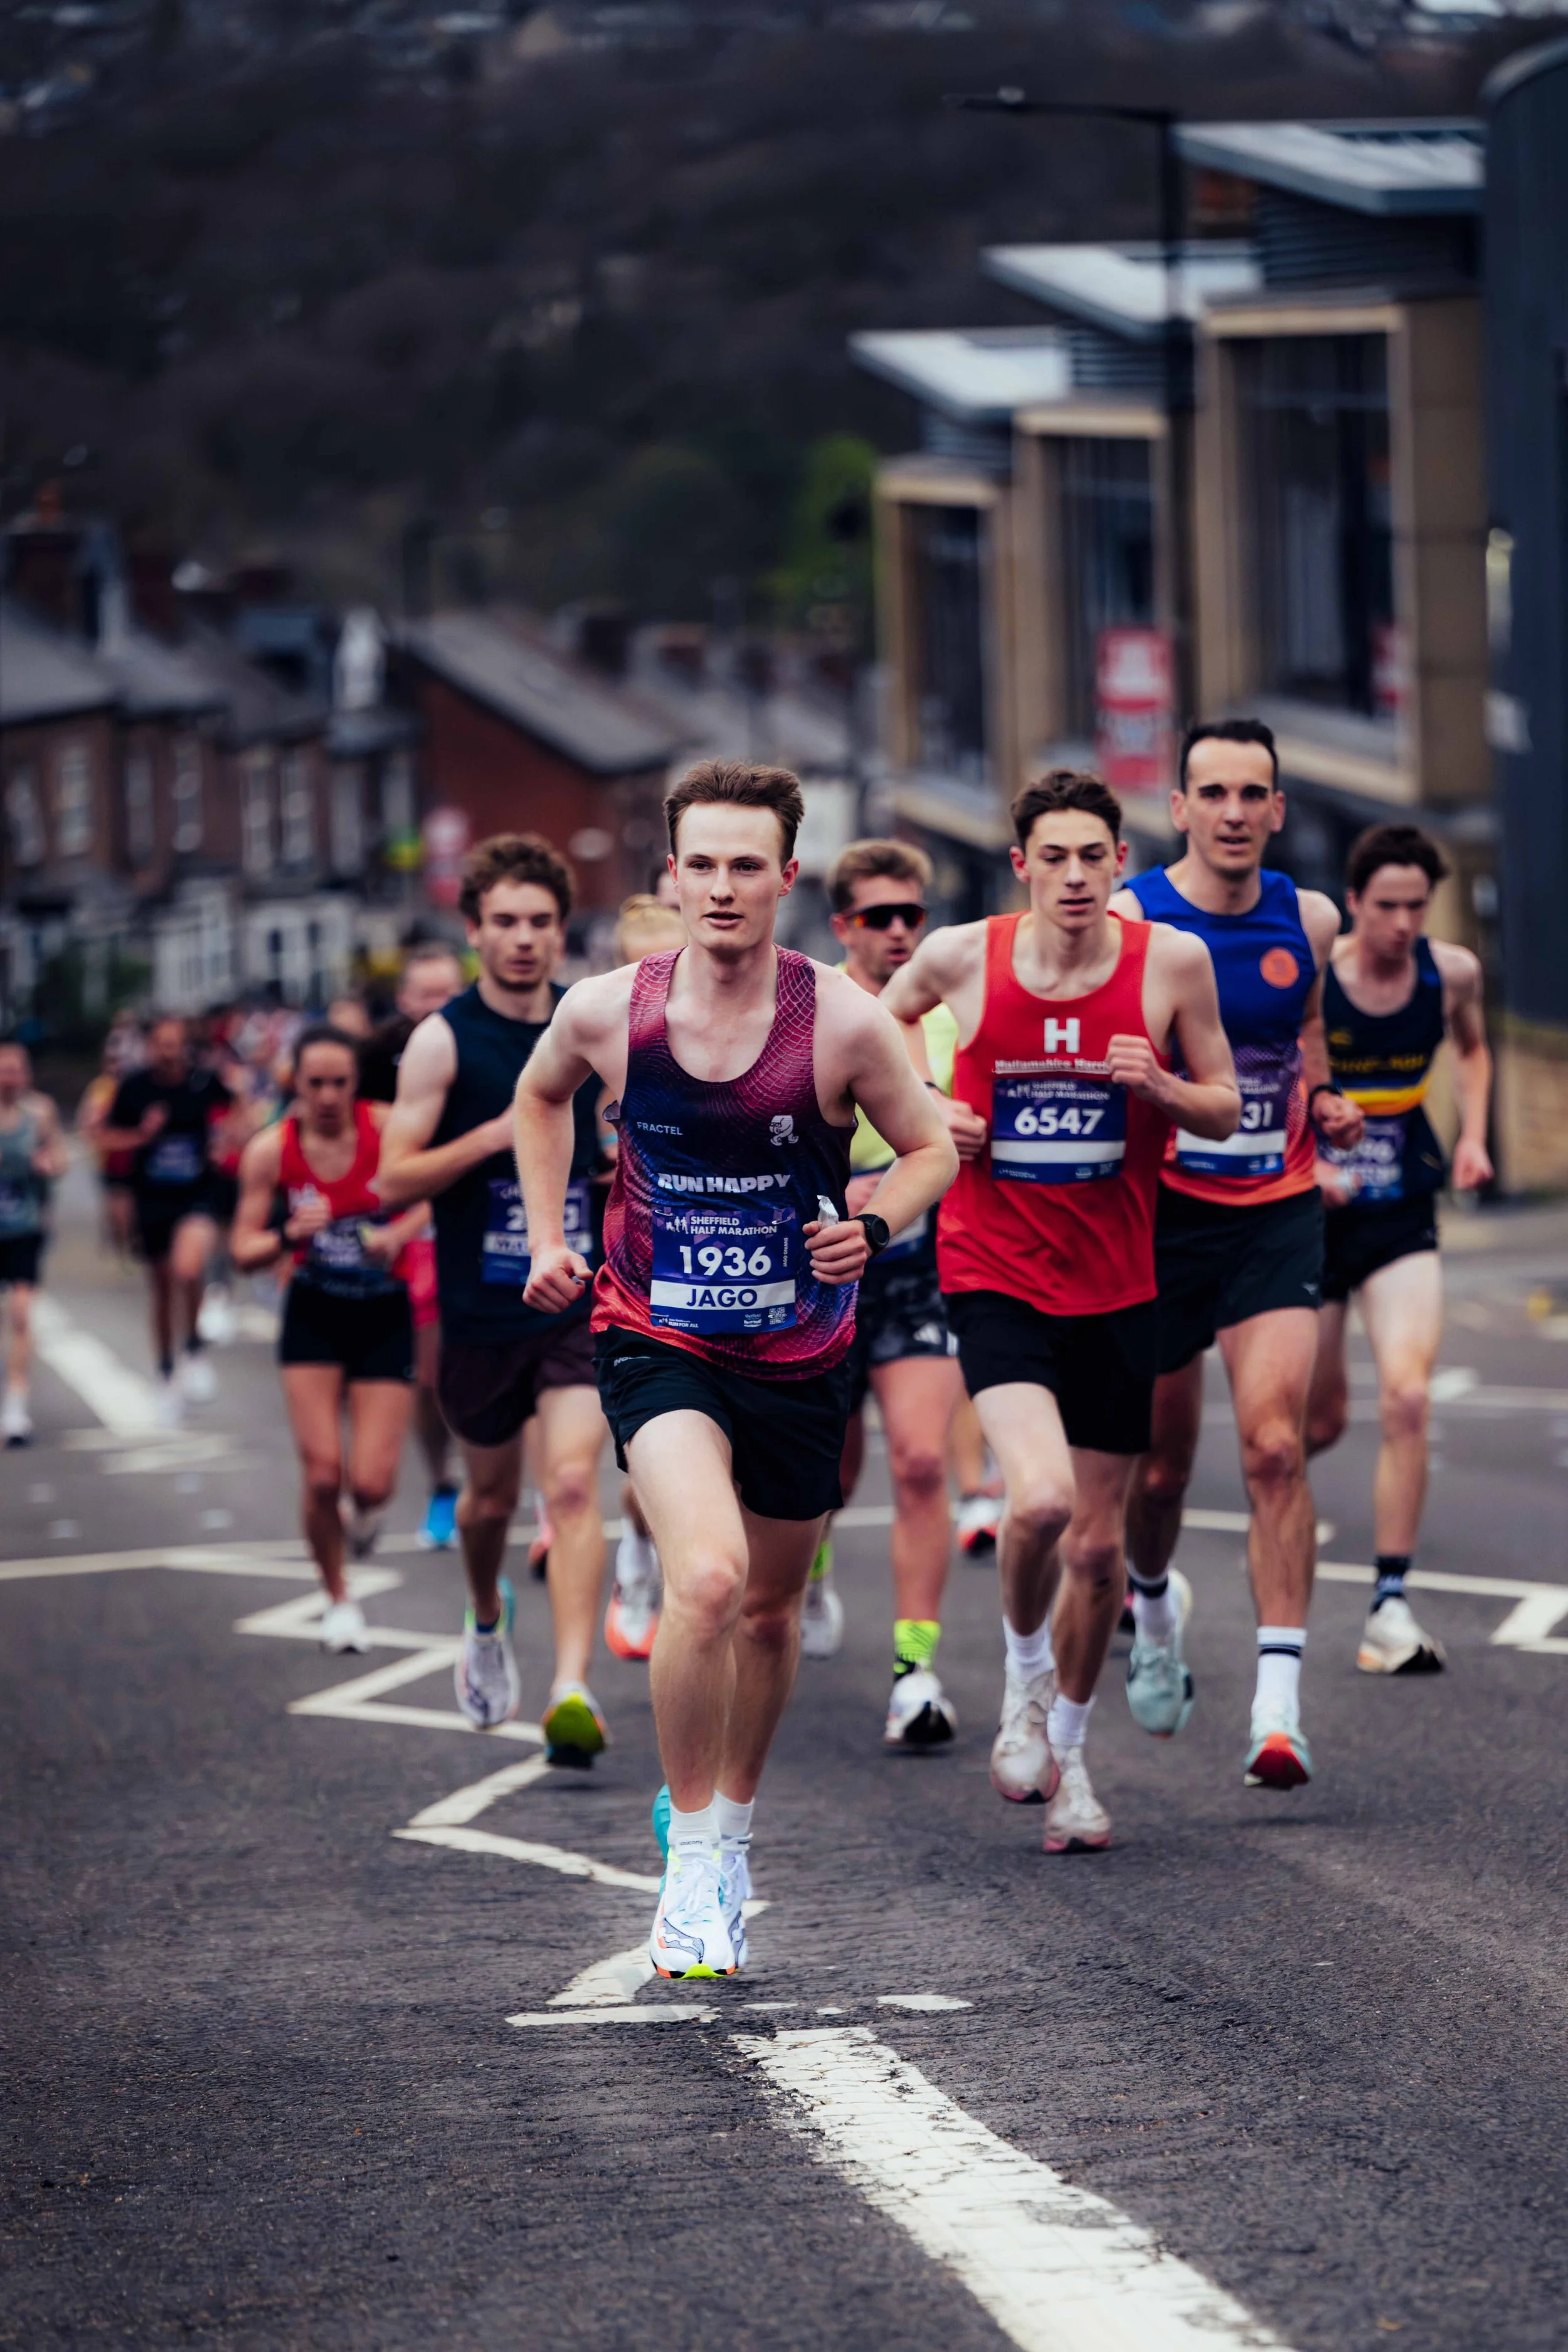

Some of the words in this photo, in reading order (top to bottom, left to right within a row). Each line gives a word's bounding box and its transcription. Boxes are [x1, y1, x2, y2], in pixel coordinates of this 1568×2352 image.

[1044, 1017, 1081, 1053] H
[637, 1121, 683, 1135] FRACTEL
[1014, 1106, 1106, 1135] 6547
[658, 1173, 704, 1192] RUN
[706, 1174, 791, 1193] HAPPY
[691, 1216, 739, 1226] SHEFFIELD
[691, 1226, 716, 1234] HALF
[718, 1226, 777, 1236] MARATHON
[679, 1246, 771, 1276] 1936
[686, 1288, 758, 1307] JAGO
